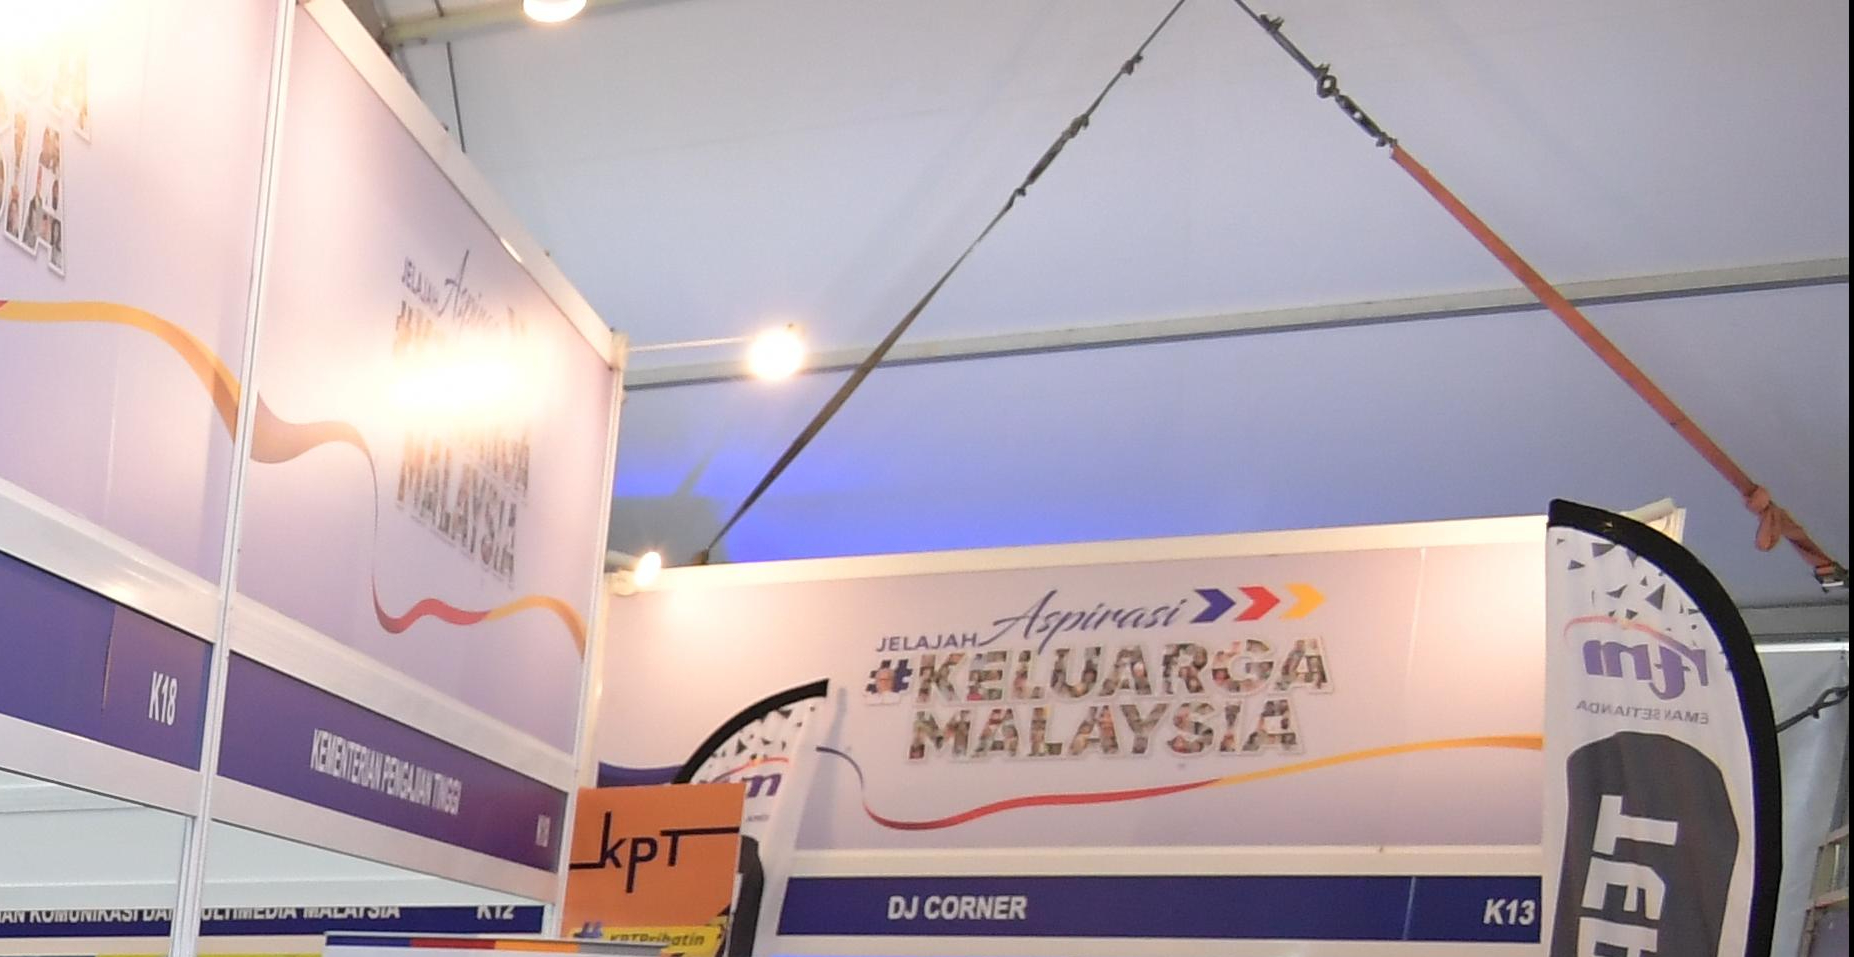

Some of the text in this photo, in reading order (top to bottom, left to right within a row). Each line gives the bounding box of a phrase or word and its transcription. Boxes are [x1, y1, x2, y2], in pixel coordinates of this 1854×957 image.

[876, 589, 1189, 655] JELAJAH Aspirasi
[863, 637, 1334, 703] #KELUARGA
[149, 671, 177, 726] K18
[906, 698, 1305, 764] MALAYSIA
[310, 728, 384, 791] KEMENTERIAN
[382, 756, 433, 806] PENGAJIAN
[29, 909, 139, 923] KOMUNIKASI
[202, 906, 400, 921] ULTIMEDIA MALAYSIA
[888, 896, 1027, 921] DJ CORNER
[1483, 899, 1536, 926] K13
